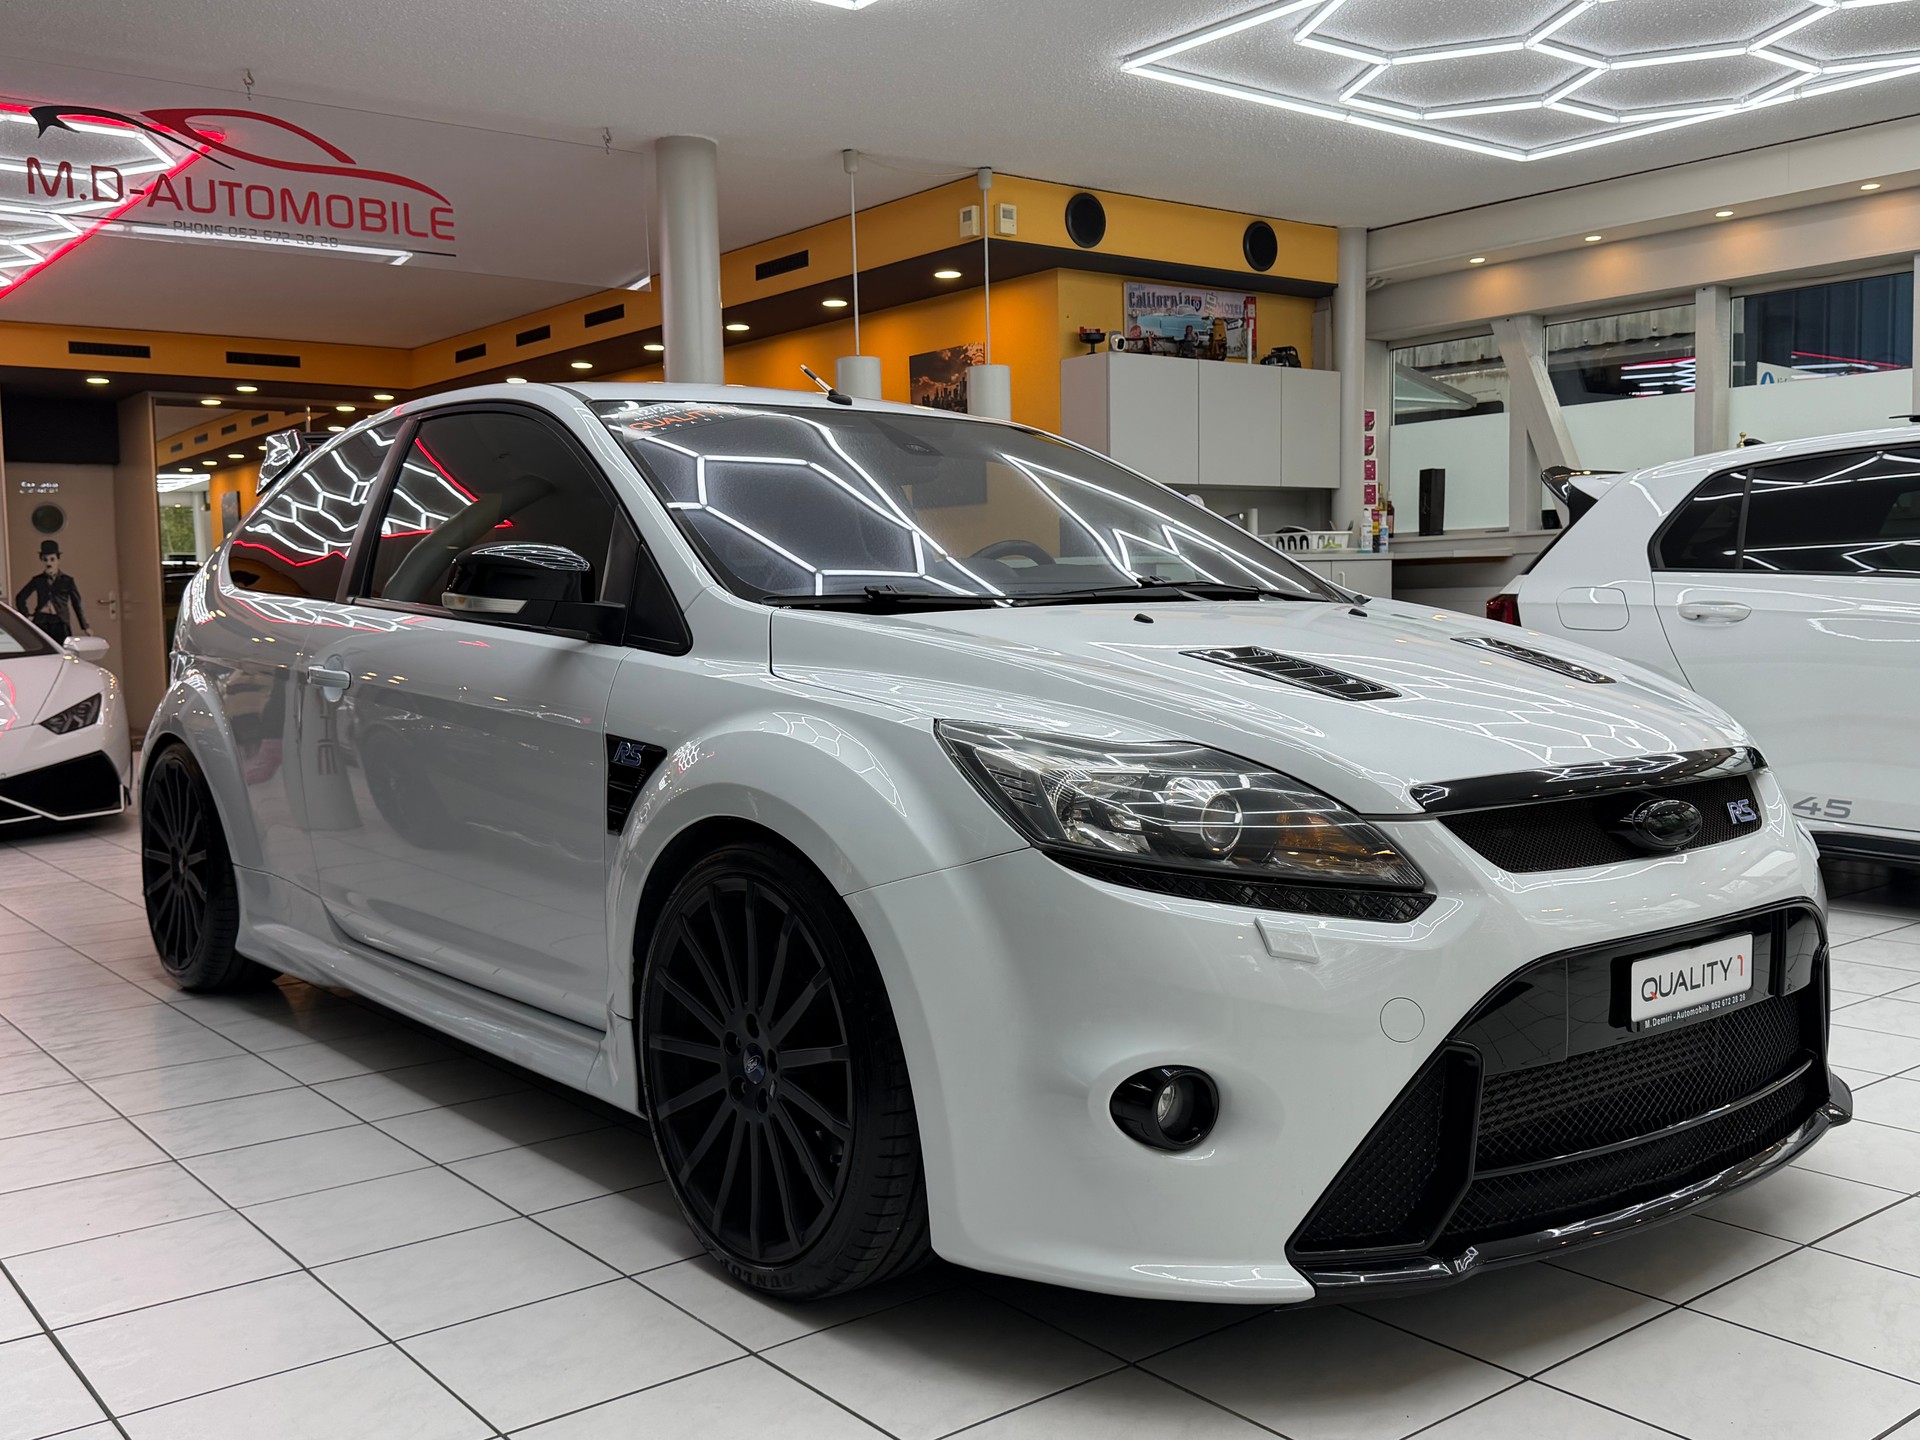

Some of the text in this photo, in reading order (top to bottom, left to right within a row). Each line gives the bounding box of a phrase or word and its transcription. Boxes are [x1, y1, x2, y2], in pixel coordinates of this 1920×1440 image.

[173, 219, 339, 248] PHONE 052 672 28 28
[1128, 291, 1192, 310] California
[613, 740, 646, 767] RS
[1726, 798, 1758, 825] RS
[1792, 796, 1853, 819] 45
[1641, 956, 1733, 1003] QUALITY
[1711, 1000, 1721, 1010] 052
[1721, 996, 1731, 1007] 672
[1732, 995, 1739, 1004] 28
[1739, 992, 1746, 1001] 28
